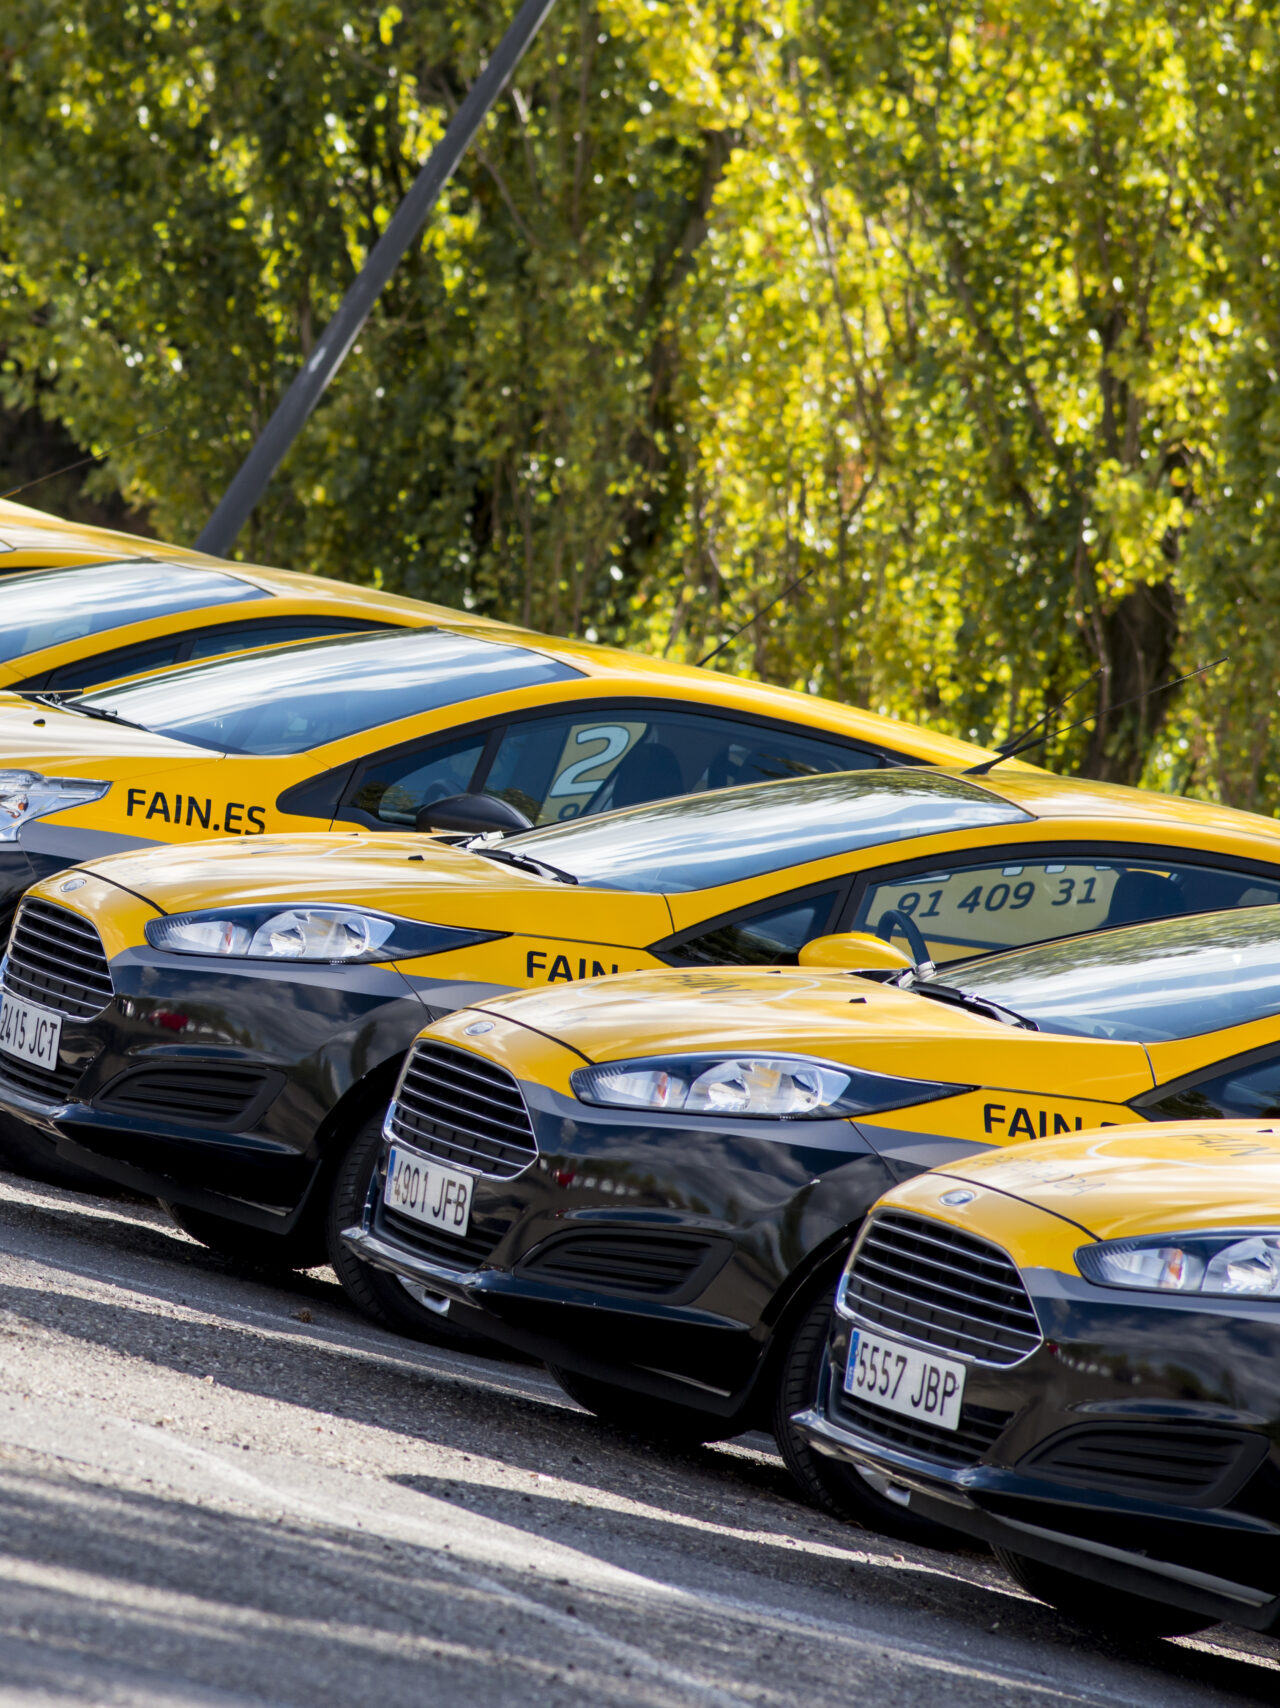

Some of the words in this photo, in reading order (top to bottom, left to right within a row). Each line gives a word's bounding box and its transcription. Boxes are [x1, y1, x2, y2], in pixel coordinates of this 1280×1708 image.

[549, 725, 631, 798] 2
[126, 788, 266, 836] FAIN.ES
[897, 890, 944, 918] 91
[957, 881, 1035, 914] 409
[1051, 876, 1096, 906] 31
[527, 951, 644, 982] FAIN
[0, 1003, 28, 1050] 2415
[29, 1017, 58, 1062] JCT
[983, 1103, 1120, 1140] FAIN
[393, 1160, 429, 1213] 4901
[432, 1177, 467, 1227] JFB
[856, 1341, 908, 1400] 5557
[911, 1363, 959, 1417] JBP
